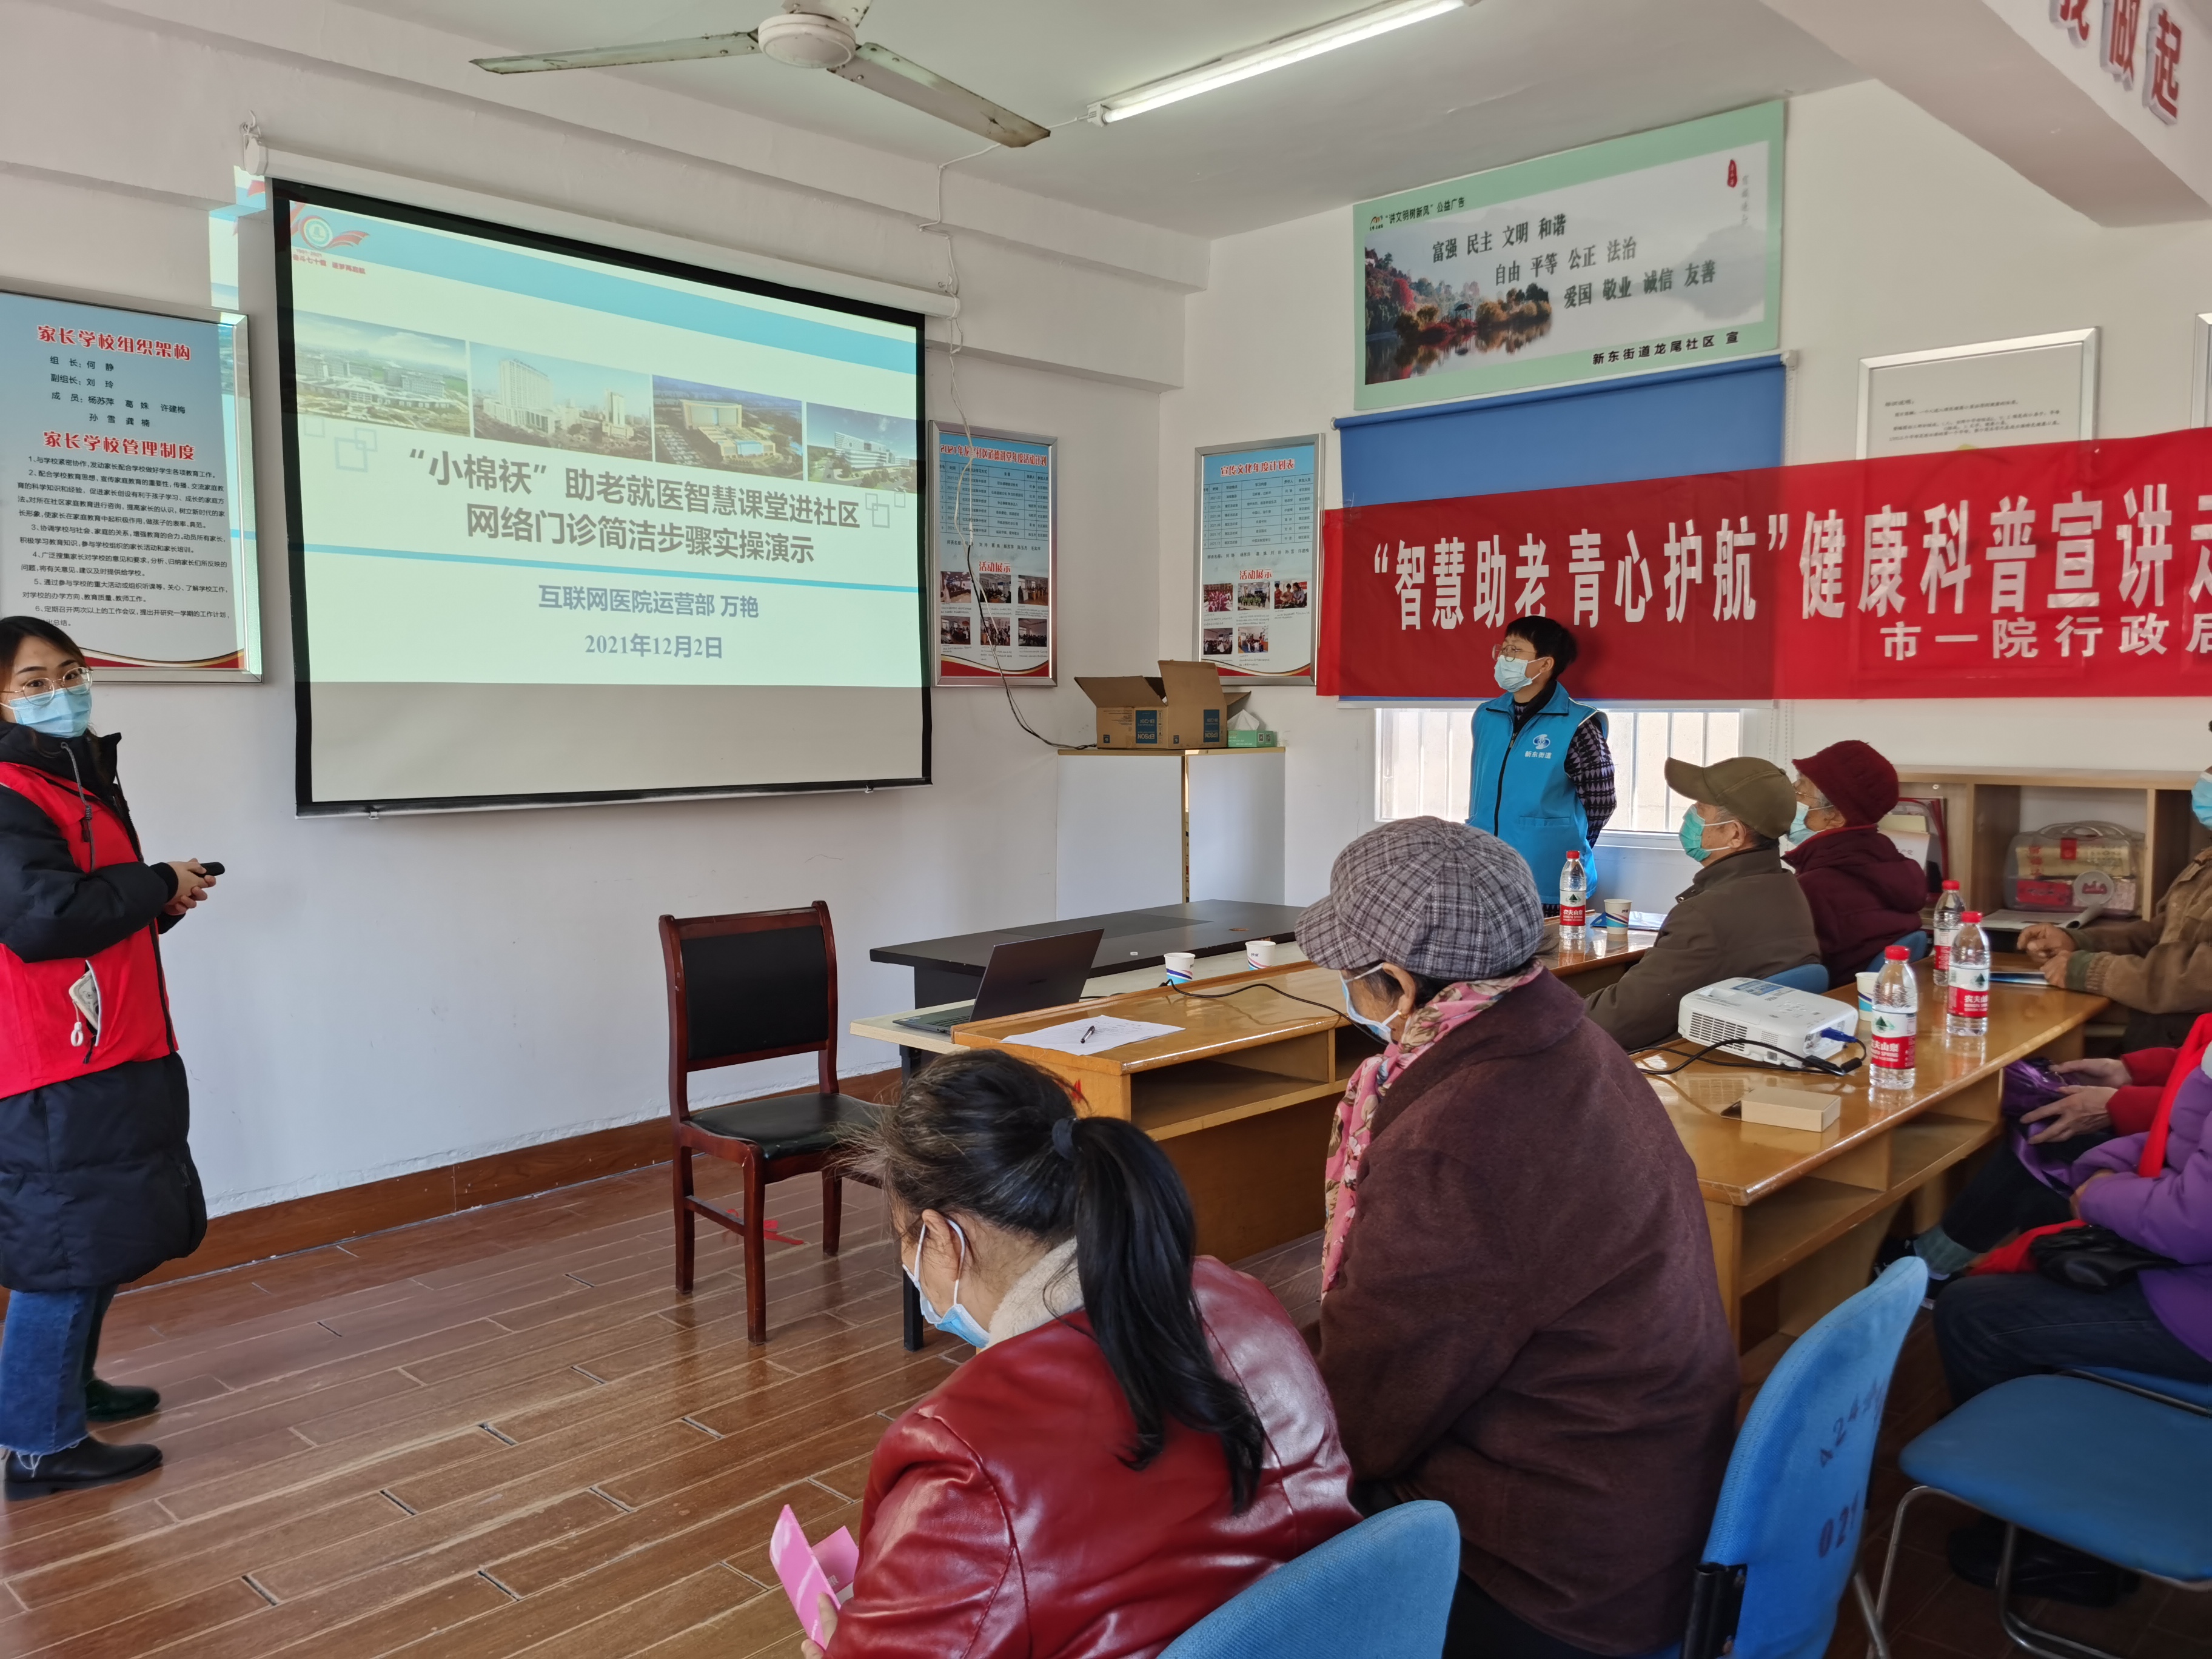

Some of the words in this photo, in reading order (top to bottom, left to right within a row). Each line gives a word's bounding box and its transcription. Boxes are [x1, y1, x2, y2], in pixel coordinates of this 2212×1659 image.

[1437, 196, 1464, 213] 公益广告
[1433, 238, 1457, 263] 富强
[1467, 231, 1492, 255] 民主
[1502, 221, 1528, 248] 文明
[1538, 213, 1566, 240] 和谐
[1496, 260, 1520, 286] 自由
[1530, 252, 1557, 278] 平等
[1568, 245, 1596, 270] 公正
[1607, 236, 1636, 263] 法治
[1564, 283, 1592, 309] 爱国
[1603, 276, 1631, 301] 敬业
[1643, 267, 1673, 294] 诚信
[1684, 260, 1715, 287] 友善
[38, 325, 190, 360] 家长学校组织架构
[1592, 335, 1715, 365] 新东街道龙尾社区
[1726, 330, 1739, 344] 宣
[88, 395, 115, 406] 杨苏萍
[43, 431, 195, 461] 家长学校管理制度
[1221, 458, 1295, 476] 宣传文化年度计划表
[565, 466, 860, 529] 助老就医智慧课堂进社区
[466, 503, 814, 564] 网络门诊简洁步骤实操演示
[979, 561, 1010, 572] 活动展示
[1239, 569, 1272, 580] 活动展示
[538, 585, 716, 617] 互联网医院运营部
[720, 595, 759, 618] 万艳
[585, 634, 723, 659] 2021年12月2日
[1871, 1038, 1899, 1052] 夫山泉
